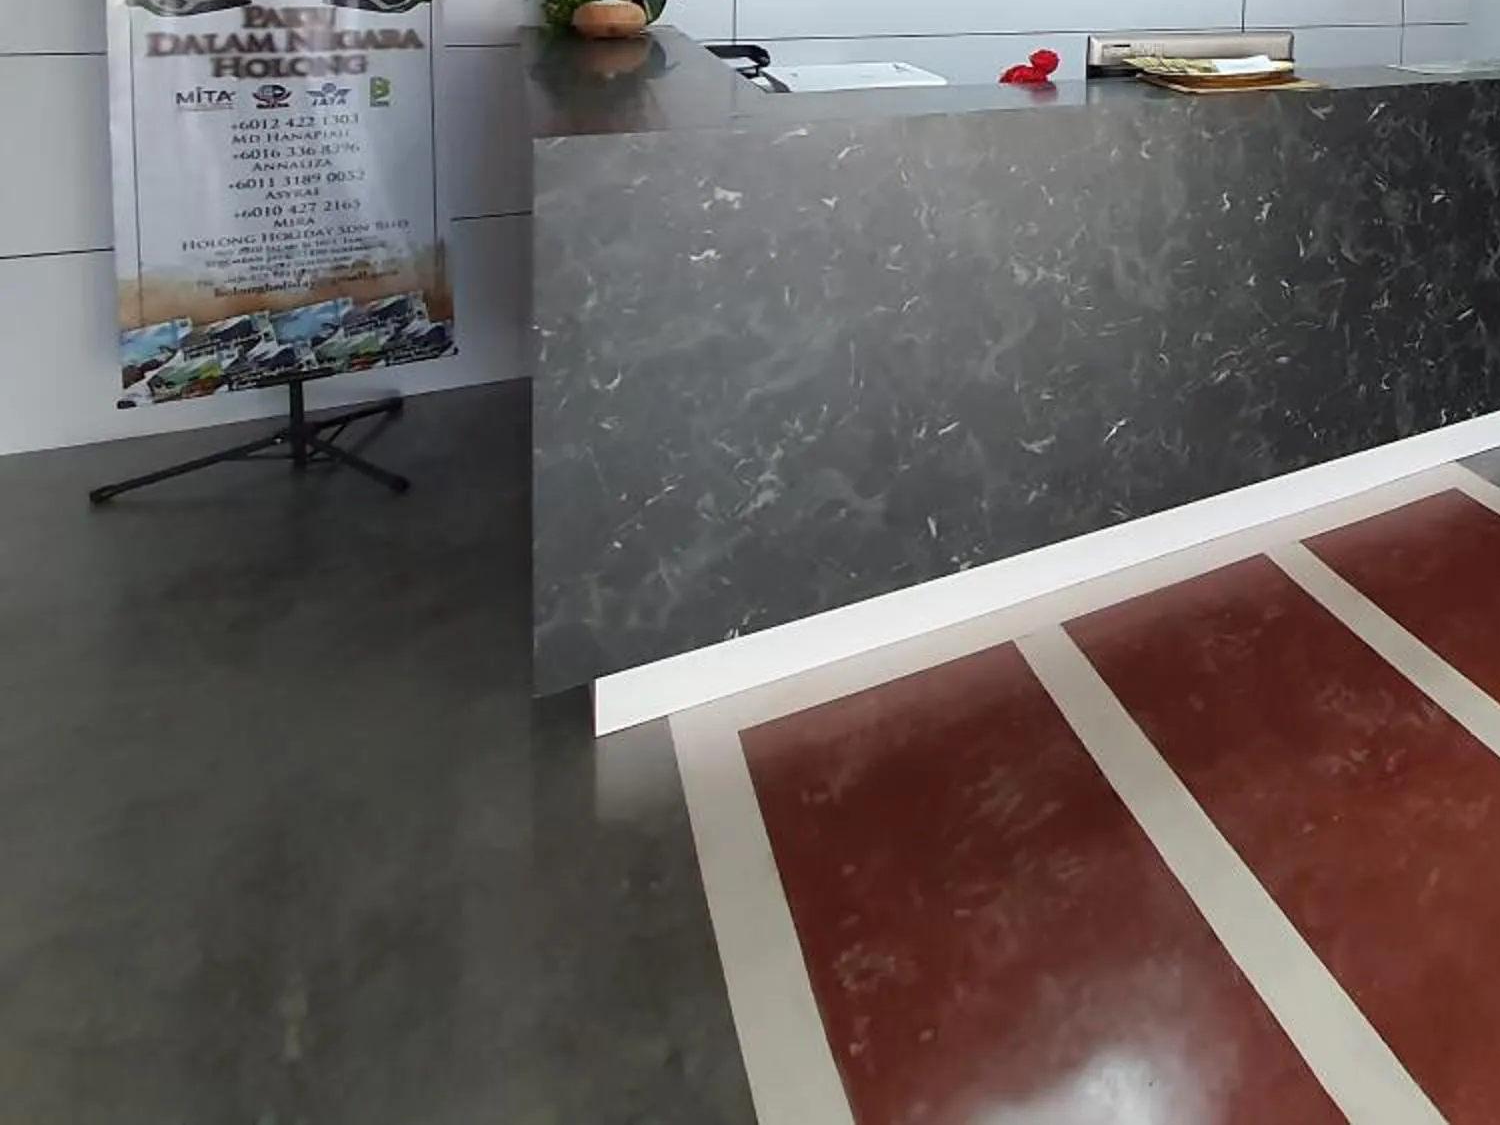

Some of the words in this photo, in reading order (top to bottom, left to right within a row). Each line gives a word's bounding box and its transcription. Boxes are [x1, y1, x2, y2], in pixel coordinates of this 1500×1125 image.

[146, 31, 277, 56] DALAM
[286, 29, 424, 53] NGARA
[211, 54, 368, 80] HOLONG
